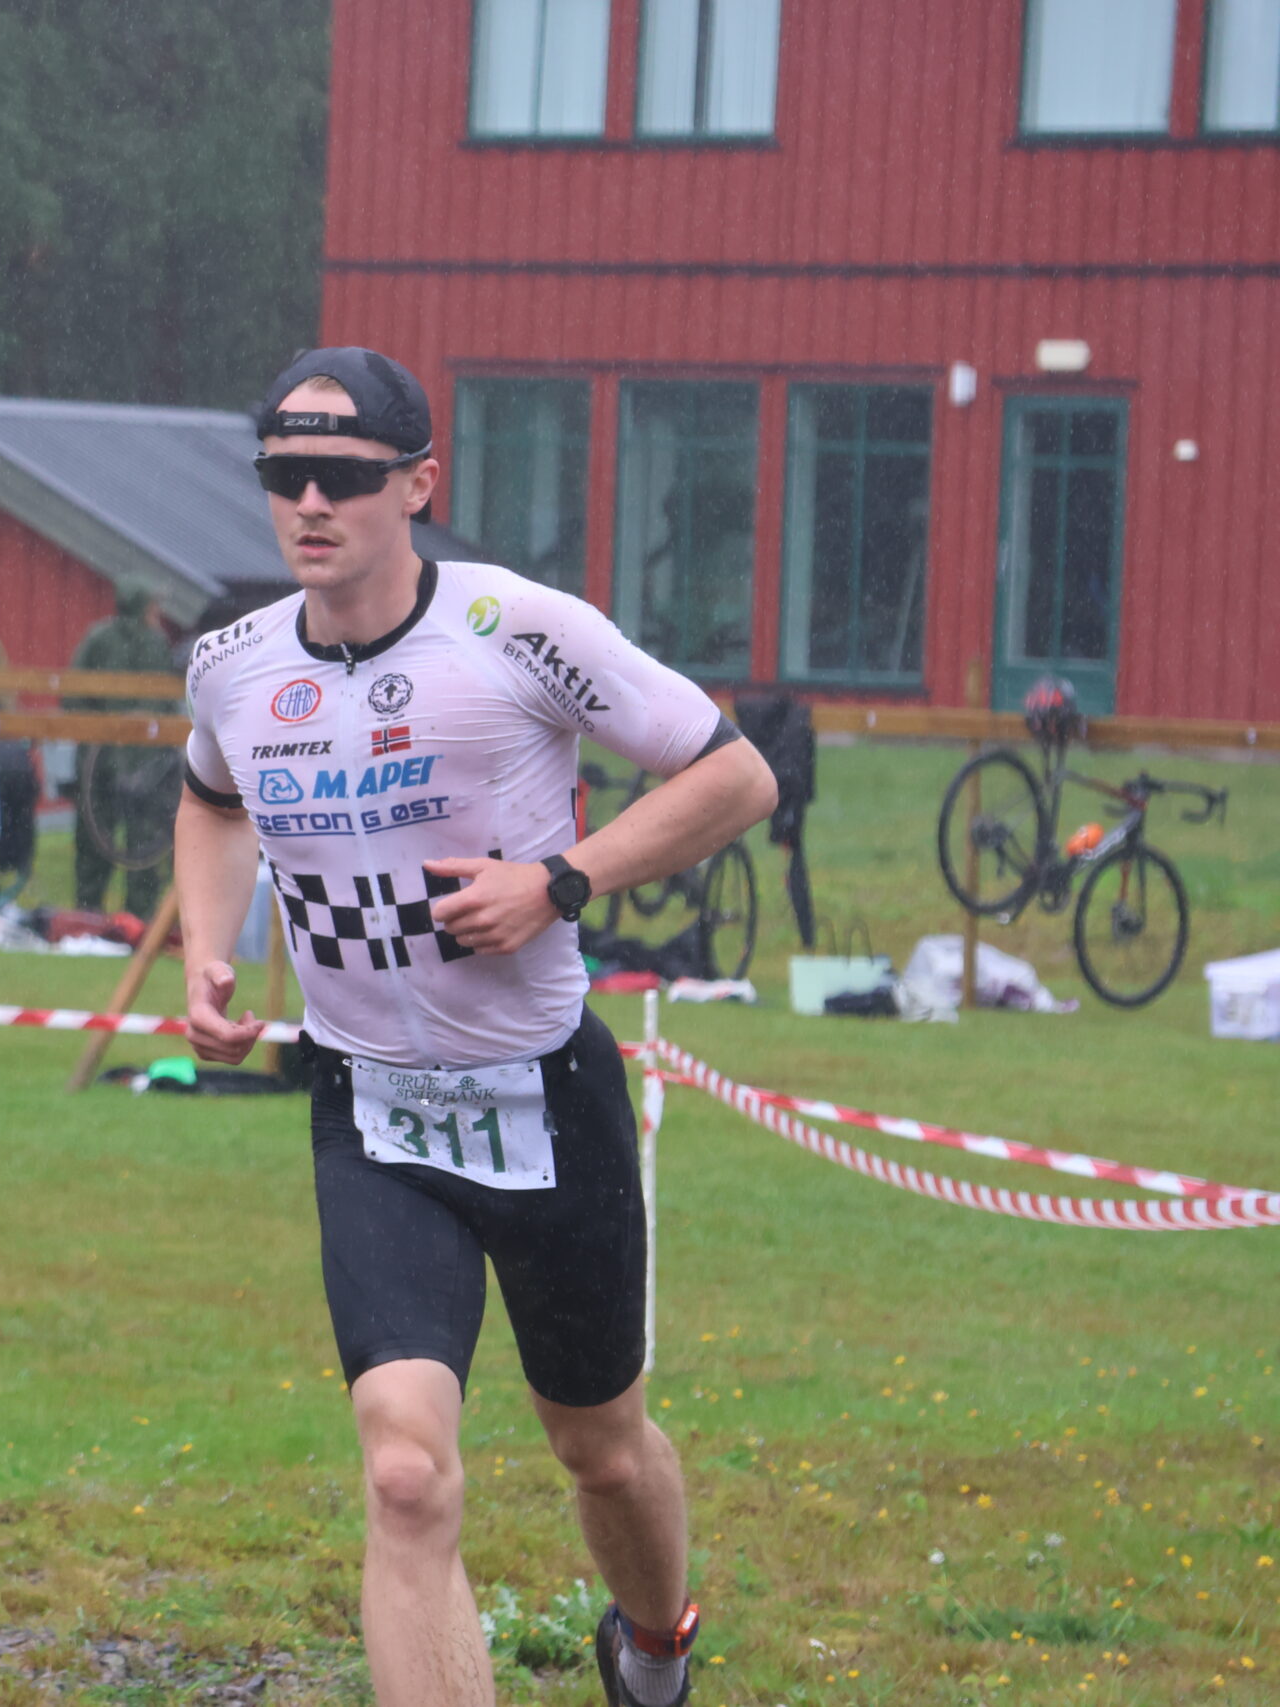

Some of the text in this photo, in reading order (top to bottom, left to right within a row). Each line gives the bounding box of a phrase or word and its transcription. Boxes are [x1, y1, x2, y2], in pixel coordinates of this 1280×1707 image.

[502, 642, 596, 733] BEMANNING
[510, 632, 612, 712] Aktiv
[251, 740, 334, 760] TRIMTEX
[388, 1072, 440, 1091] GRUE
[387, 1106, 507, 1174] 311
